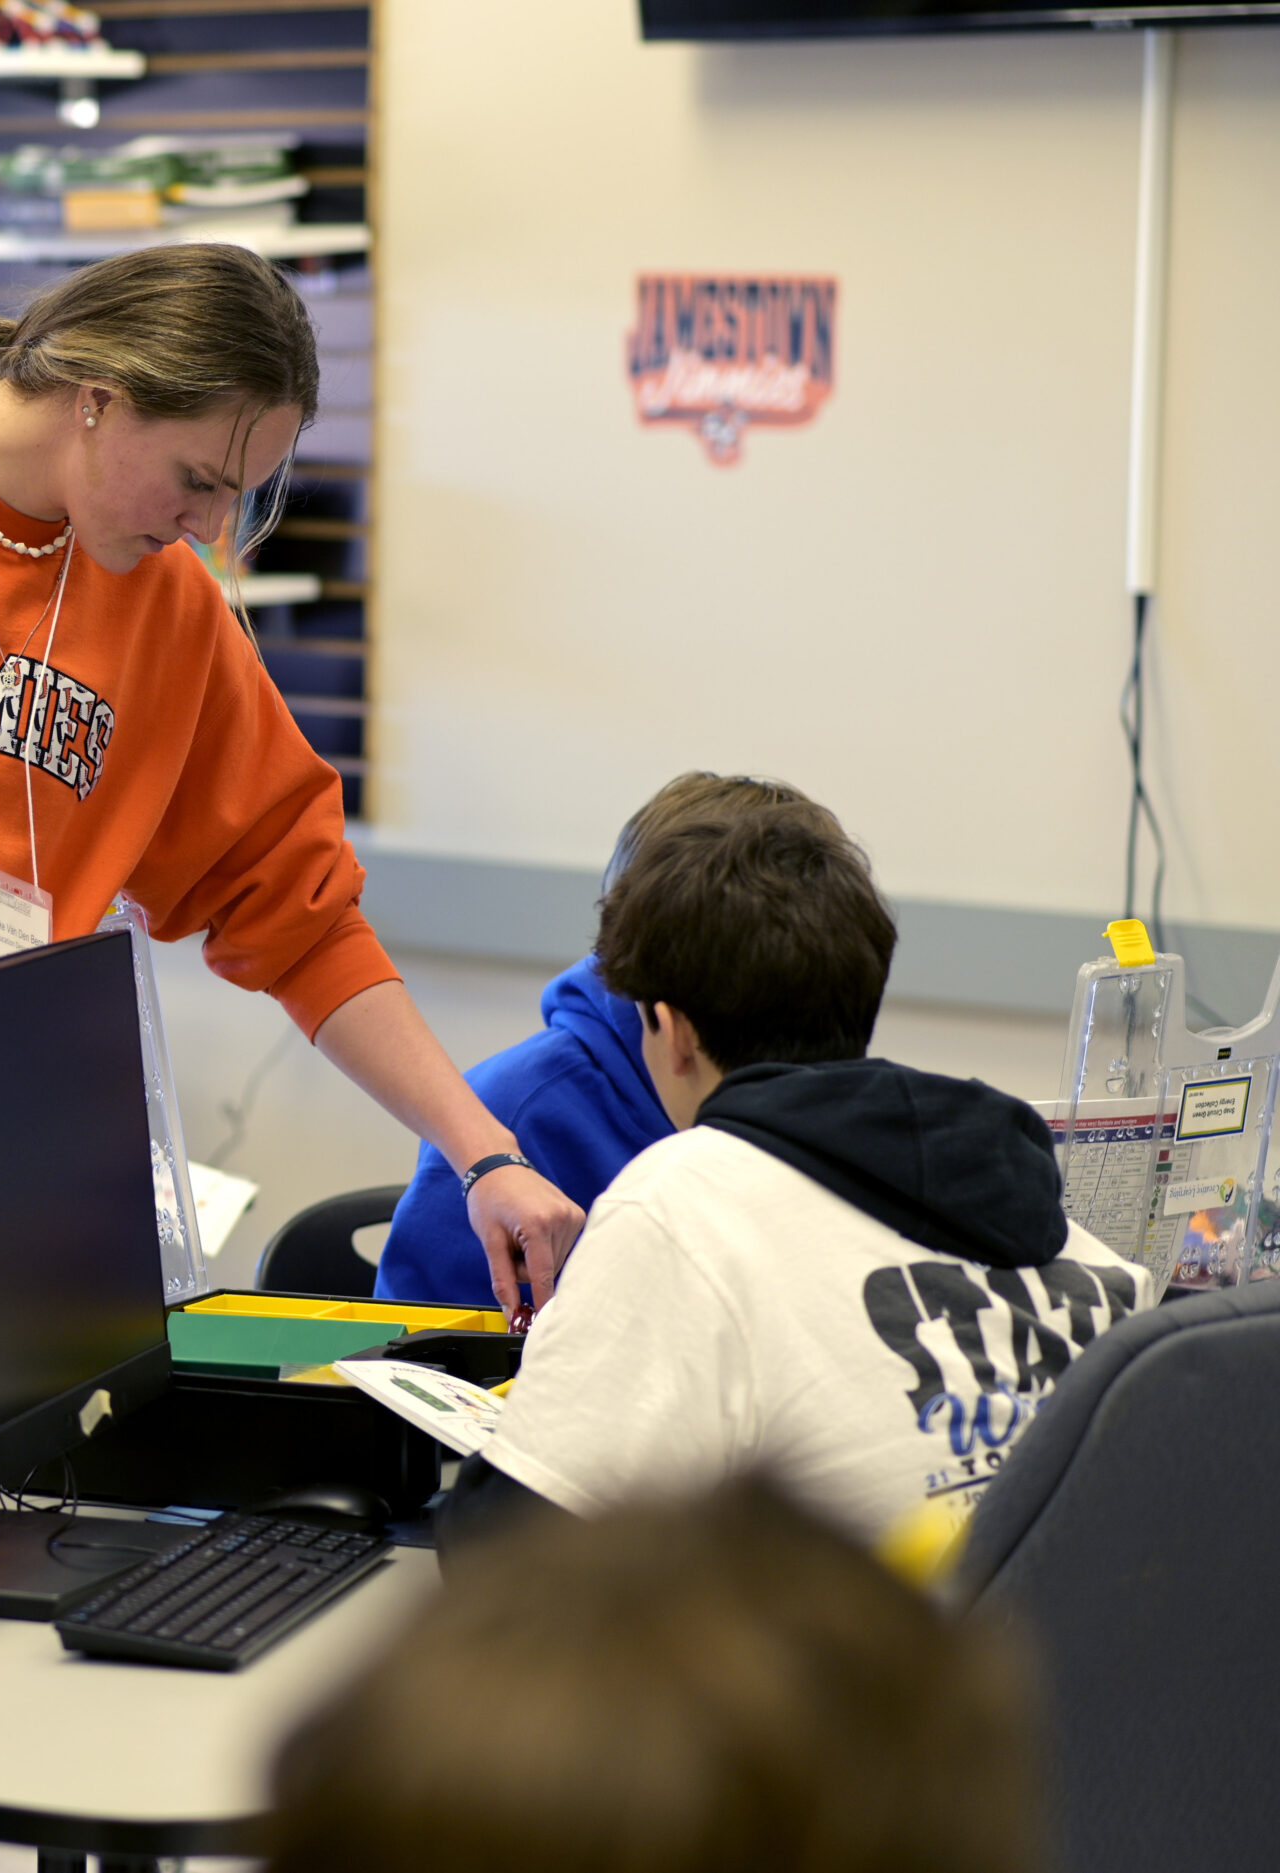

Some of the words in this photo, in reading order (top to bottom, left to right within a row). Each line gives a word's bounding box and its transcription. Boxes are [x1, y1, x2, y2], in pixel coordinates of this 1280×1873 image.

[629, 277, 837, 385] JAMESTOWN
[1195, 1100, 1219, 1109] Collection
[1192, 1111, 1207, 1119] Green
[1168, 1188, 1196, 1199] Learning
[1196, 1184, 1220, 1195] Creative
